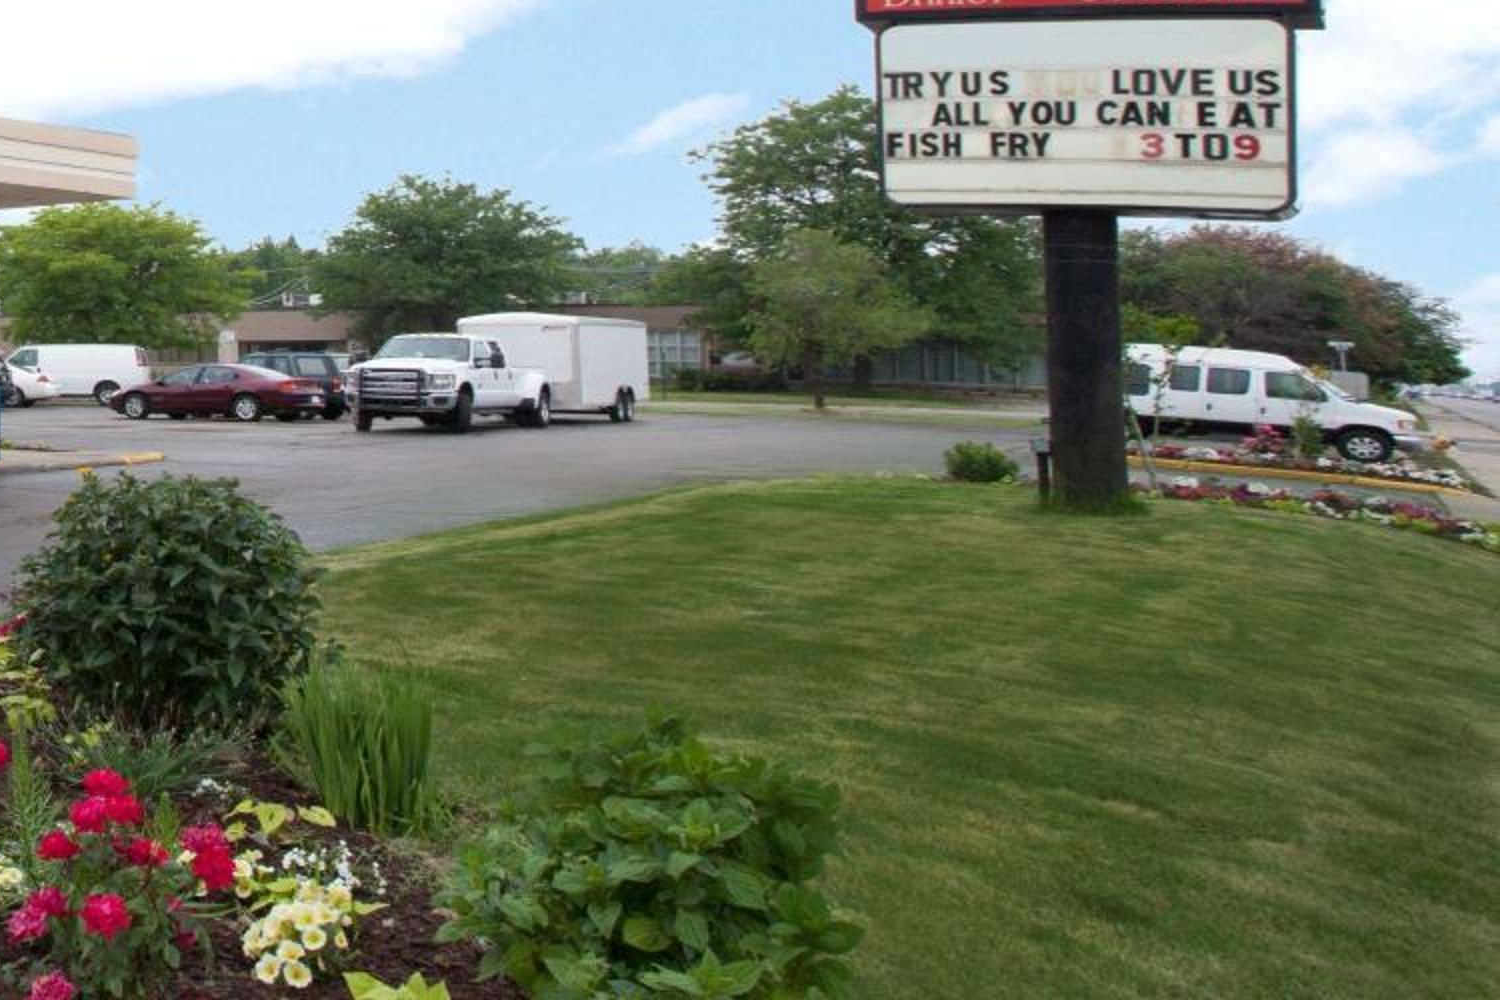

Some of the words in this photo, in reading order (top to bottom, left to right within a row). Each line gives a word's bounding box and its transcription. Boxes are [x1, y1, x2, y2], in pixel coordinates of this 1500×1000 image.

[1112, 68, 1215, 97] LOVE
[1228, 69, 1281, 96] US
[932, 101, 989, 127] ALL
[1007, 100, 1076, 126] YOU
[1096, 101, 1170, 127] CAN
[1197, 102, 1281, 129] EAT
[886, 132, 962, 159] FISH
[990, 131, 1051, 158] FRY
[1139, 134, 1166, 160] 3
[1234, 134, 1262, 161] 9
